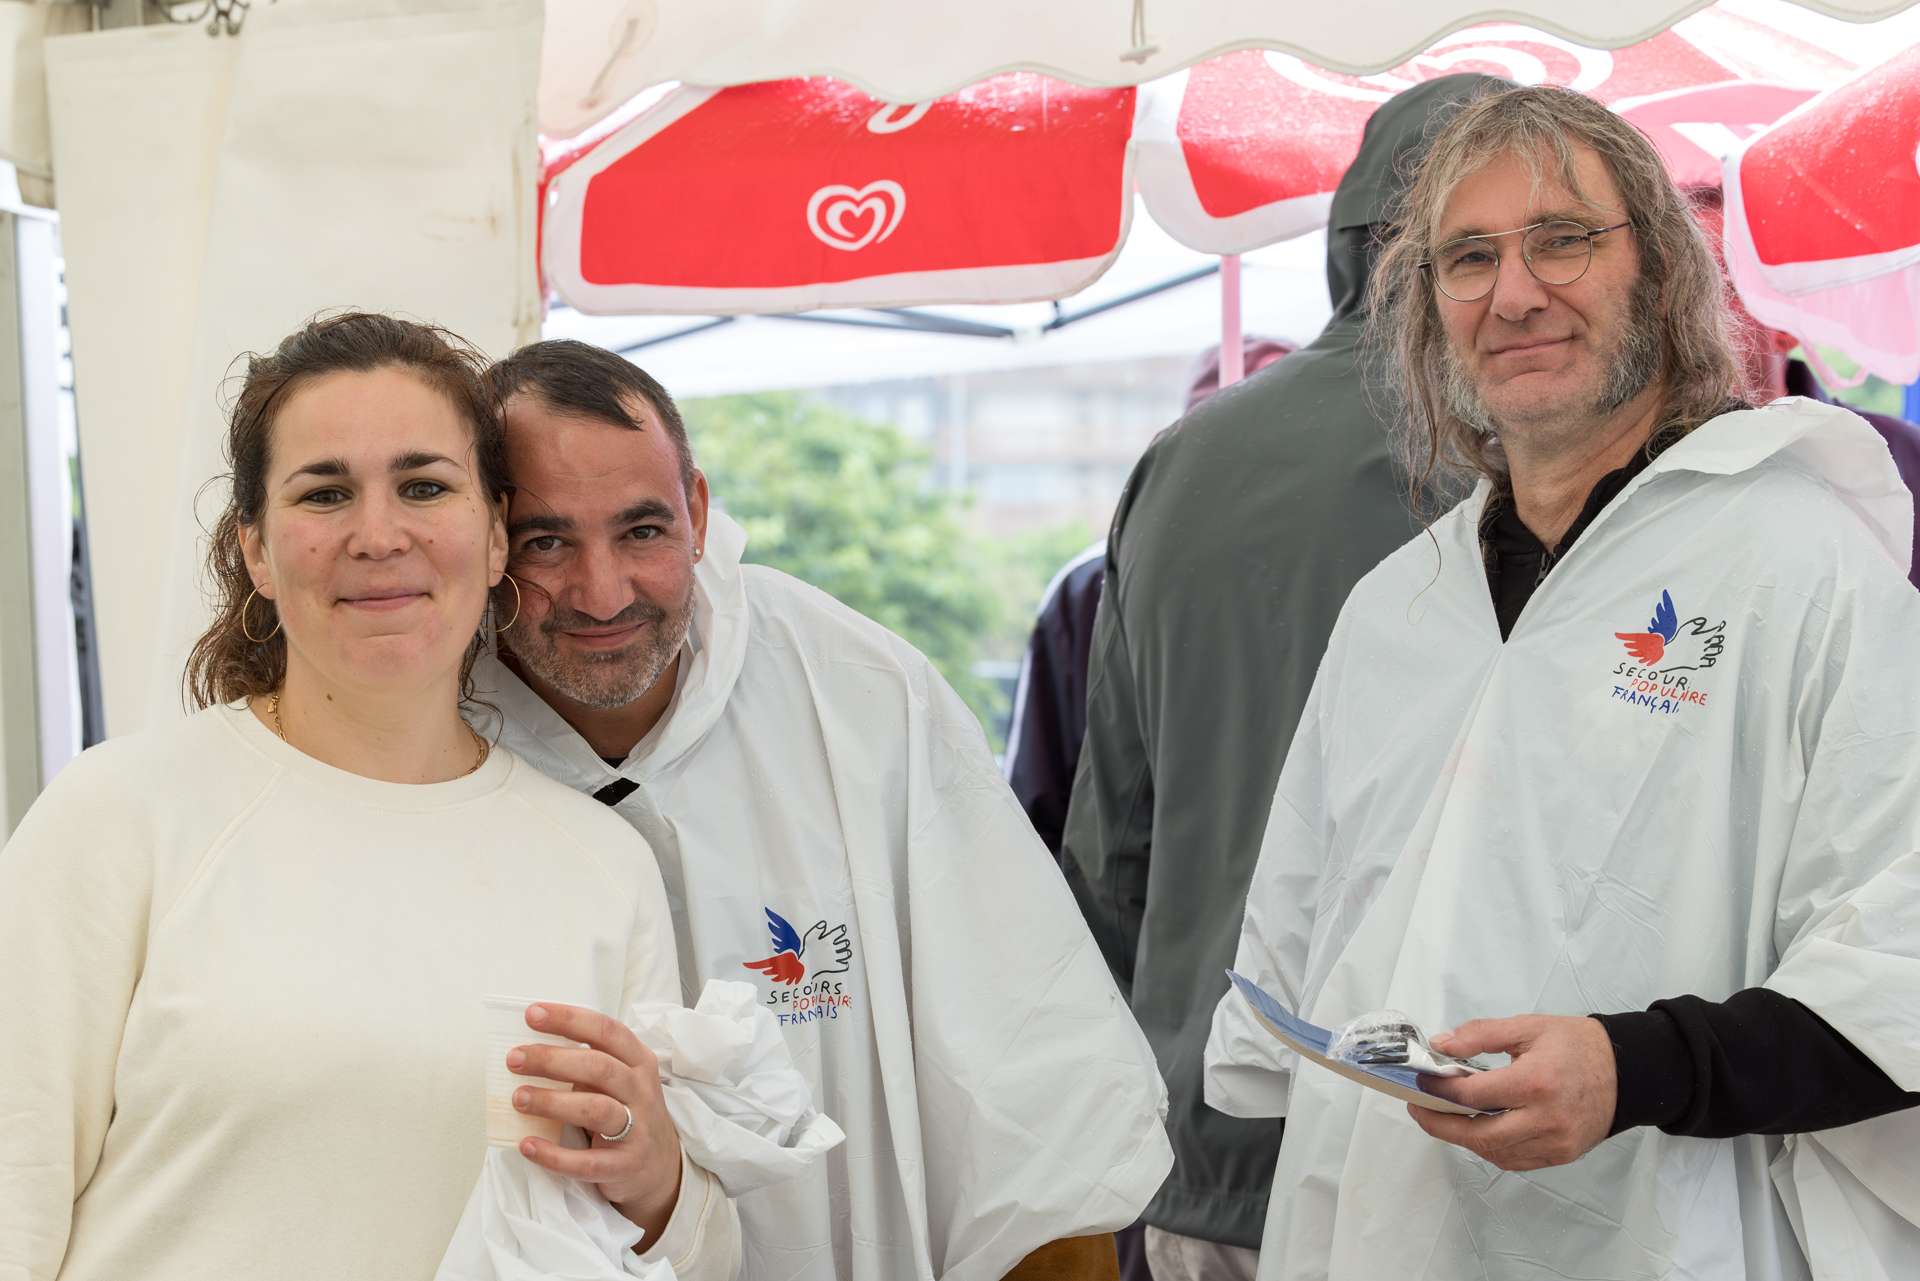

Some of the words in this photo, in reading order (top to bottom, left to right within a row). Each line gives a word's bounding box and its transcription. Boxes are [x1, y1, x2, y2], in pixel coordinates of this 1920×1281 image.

[1613, 662, 1690, 690] SECOUR
[1612, 686, 1680, 714] FRANÇAI
[778, 1005, 838, 1026] FRANAIS
